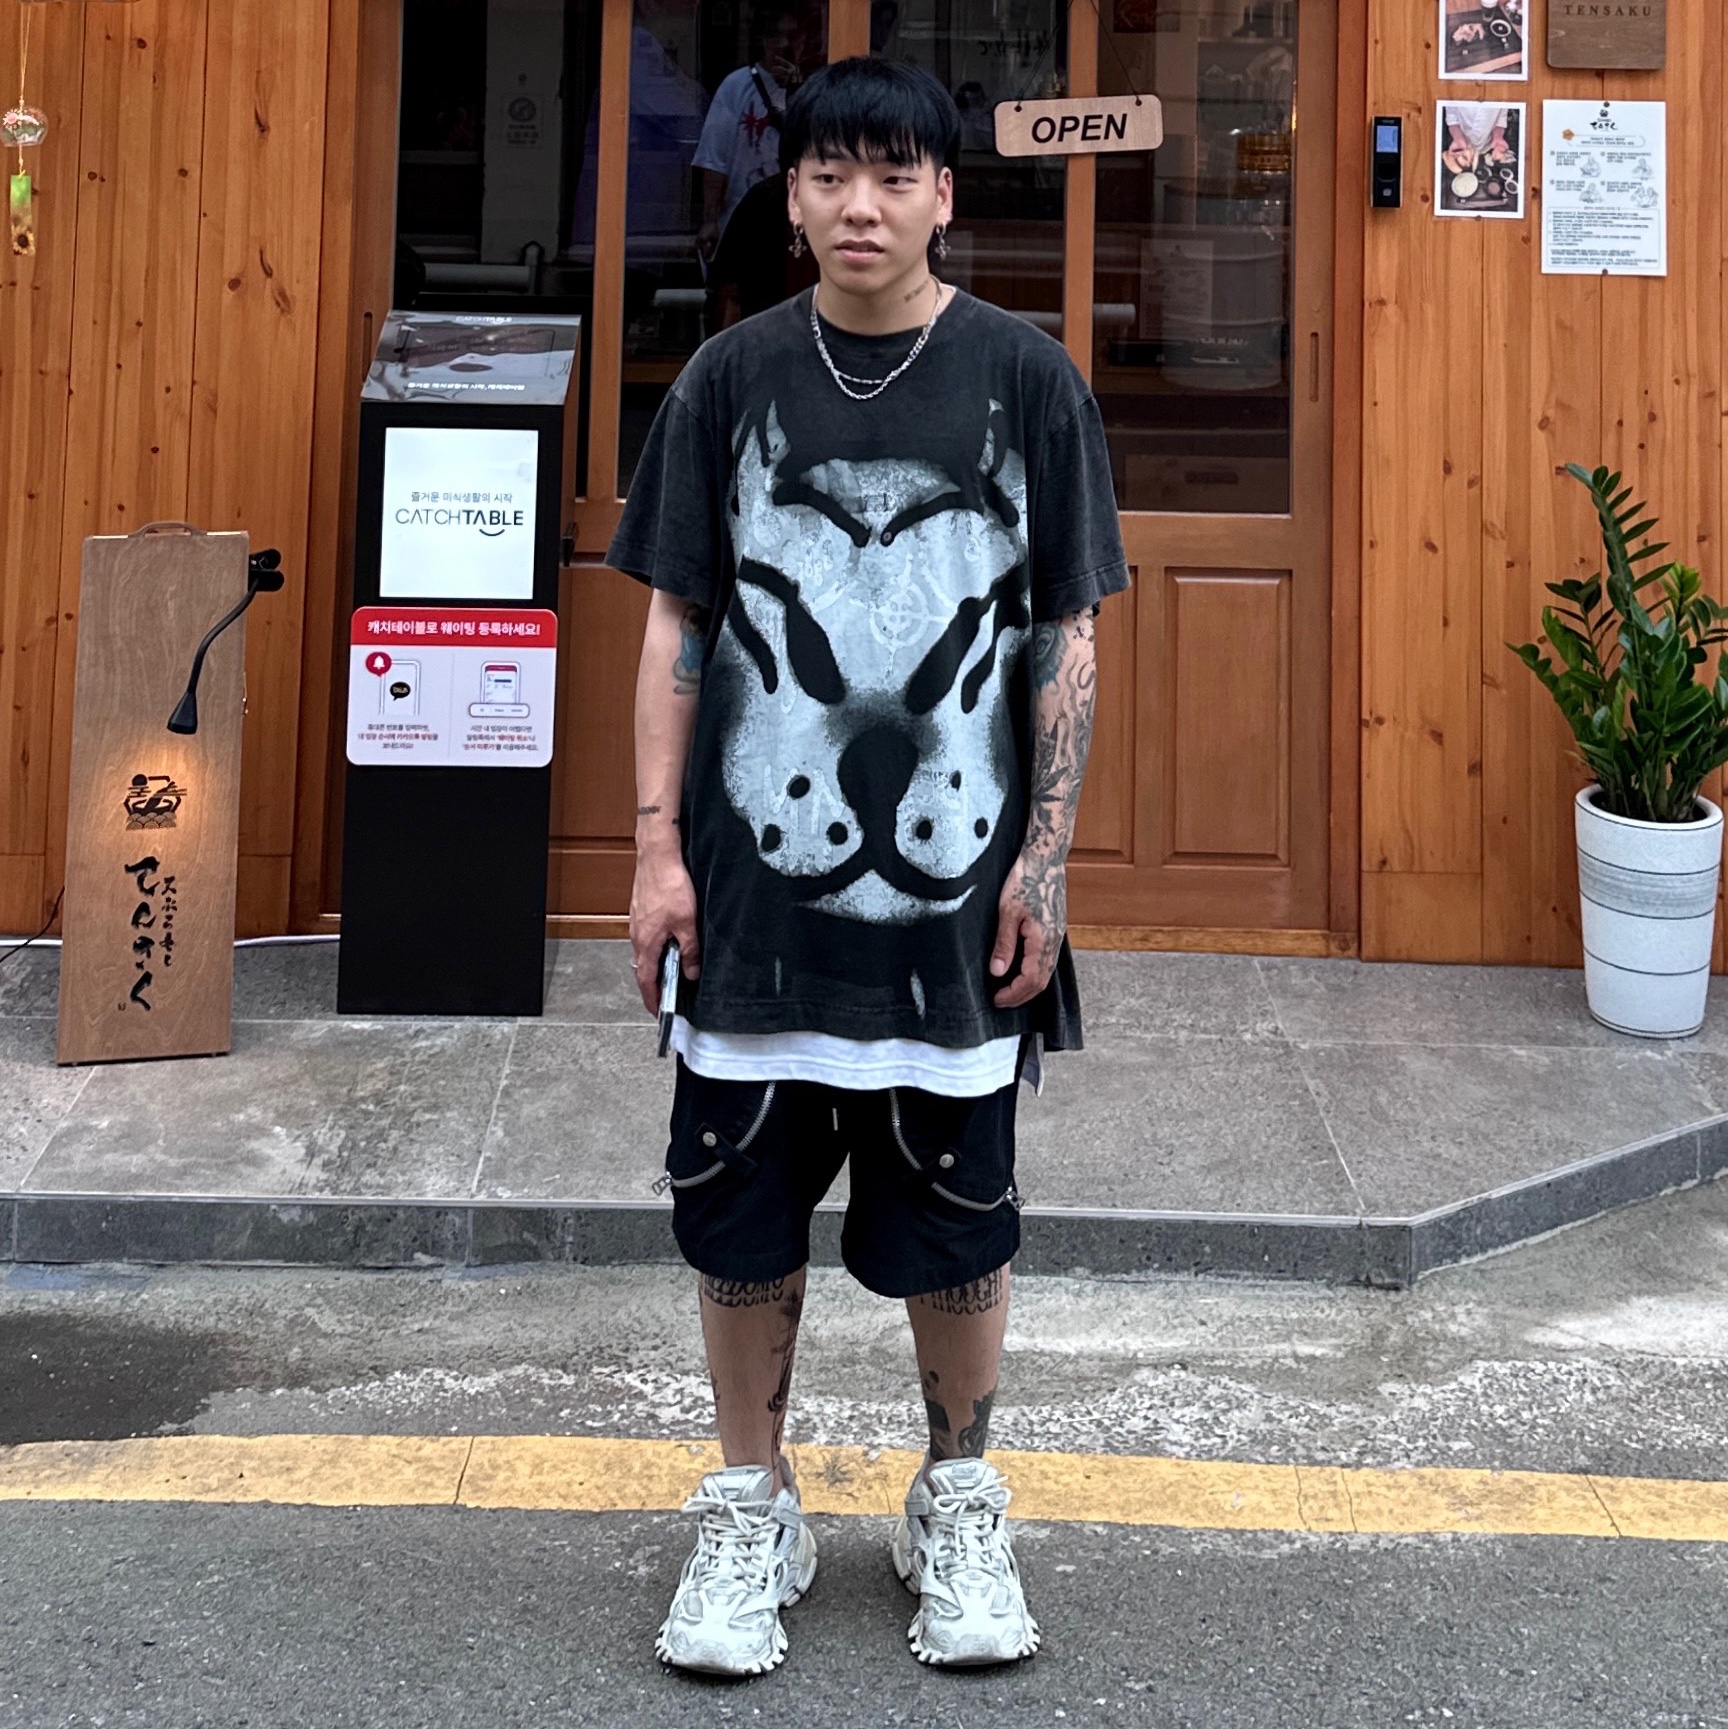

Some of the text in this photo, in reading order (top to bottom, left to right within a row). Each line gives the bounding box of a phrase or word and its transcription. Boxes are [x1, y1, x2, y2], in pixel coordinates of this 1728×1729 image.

[1564, 5, 1652, 17] TENSAKU
[1032, 113, 1128, 144] OPEN
[411, 491, 512, 504] 즐거운 미식생활의 시작
[395, 508, 524, 527] CATCHTABLE
[367, 620, 541, 637] 캐치테이블로 웨이팅 등록하세요!
[124, 855, 161, 1013] てんさく
